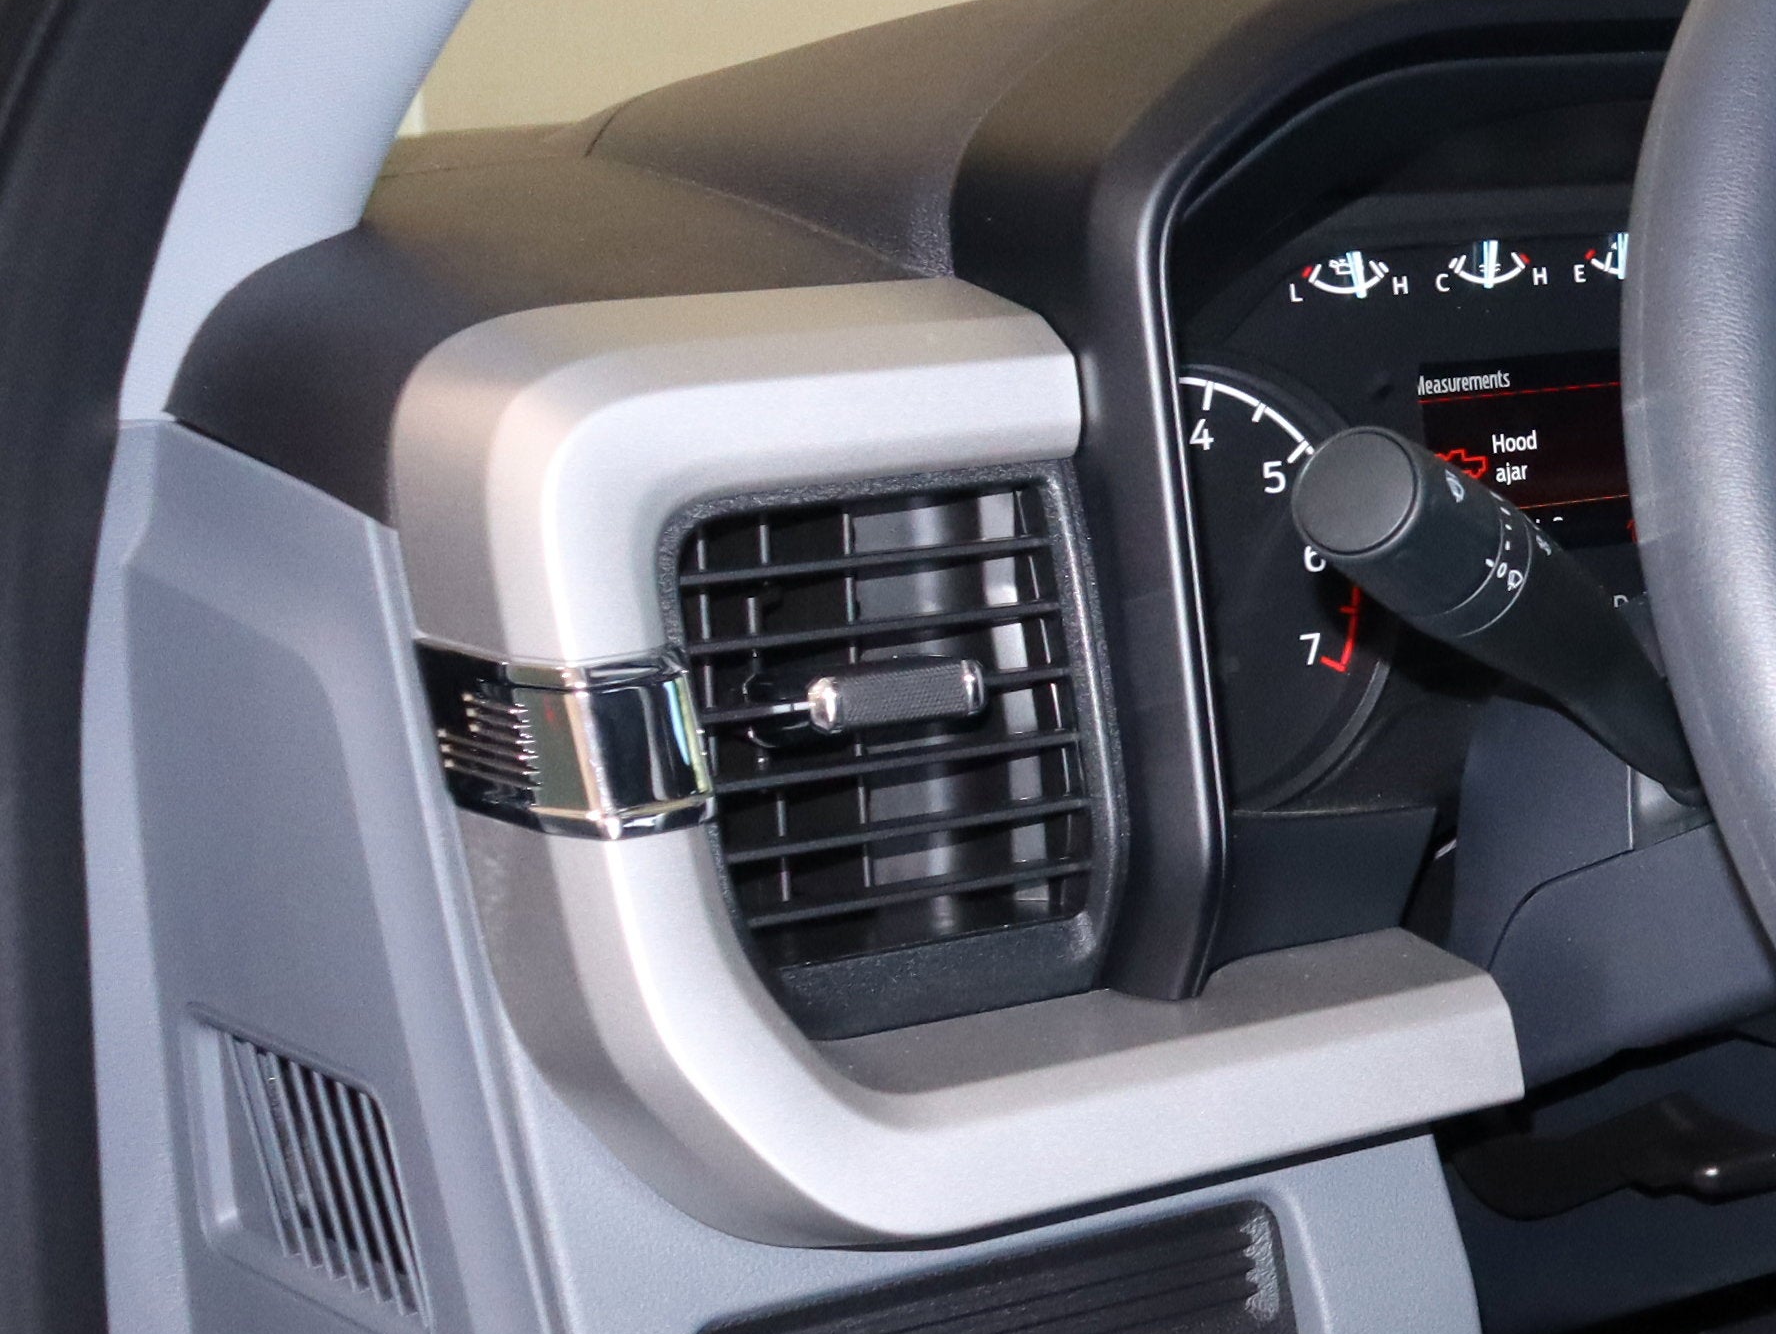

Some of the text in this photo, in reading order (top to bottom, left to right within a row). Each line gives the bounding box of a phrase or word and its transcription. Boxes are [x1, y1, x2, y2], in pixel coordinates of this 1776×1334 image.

[1392, 275, 1409, 295] H
[1435, 273, 1449, 292] C
[1533, 267, 1548, 286] H
[1573, 264, 1586, 284] E
[1289, 283, 1303, 303] L
[1189, 418, 1215, 451] 4
[1492, 429, 1538, 454] Hood
[1262, 460, 1286, 493] 5
[1495, 462, 1528, 486] ajar
[1303, 545, 1327, 573] 6
[1299, 632, 1321, 666] 7
